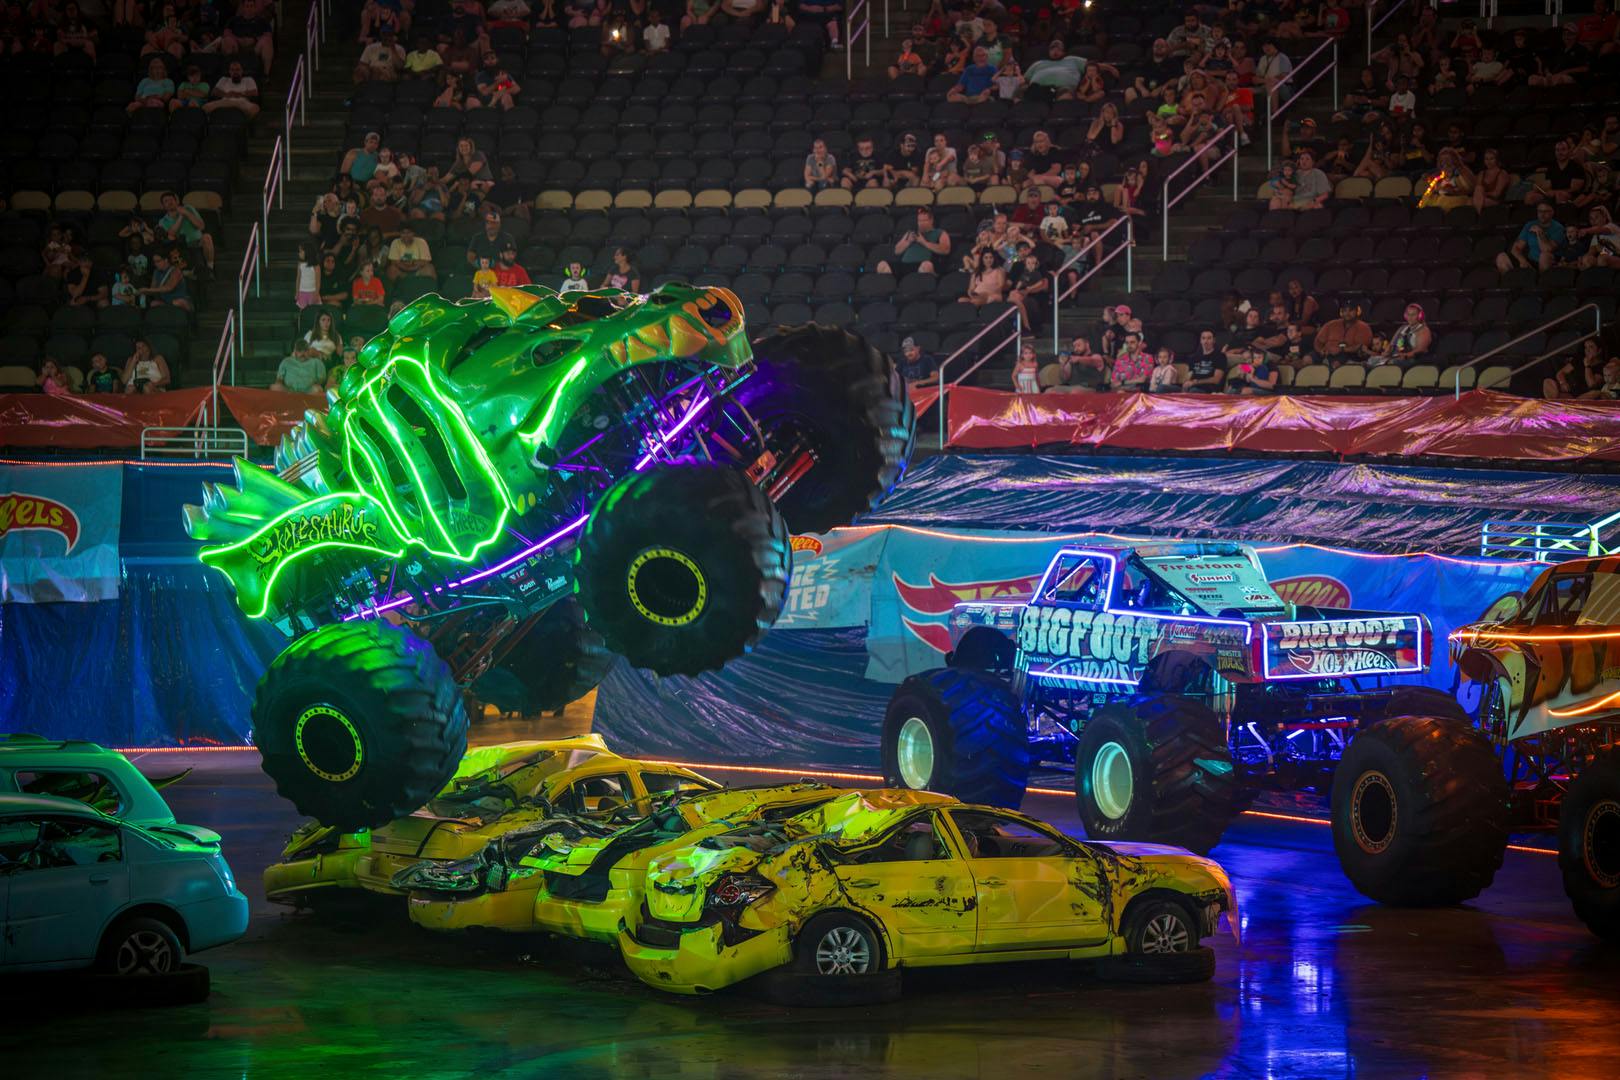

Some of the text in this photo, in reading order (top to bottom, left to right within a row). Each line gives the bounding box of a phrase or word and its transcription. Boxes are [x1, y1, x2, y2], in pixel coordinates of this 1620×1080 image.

[1157, 562, 1244, 572] Firestone
[790, 583, 831, 613] TED
[1021, 605, 1159, 665] BIGFOOT
[1279, 618, 1405, 650] BIGFOOT
[1216, 656, 1247, 674] TRUCKS
[1310, 649, 1345, 673] HOT
